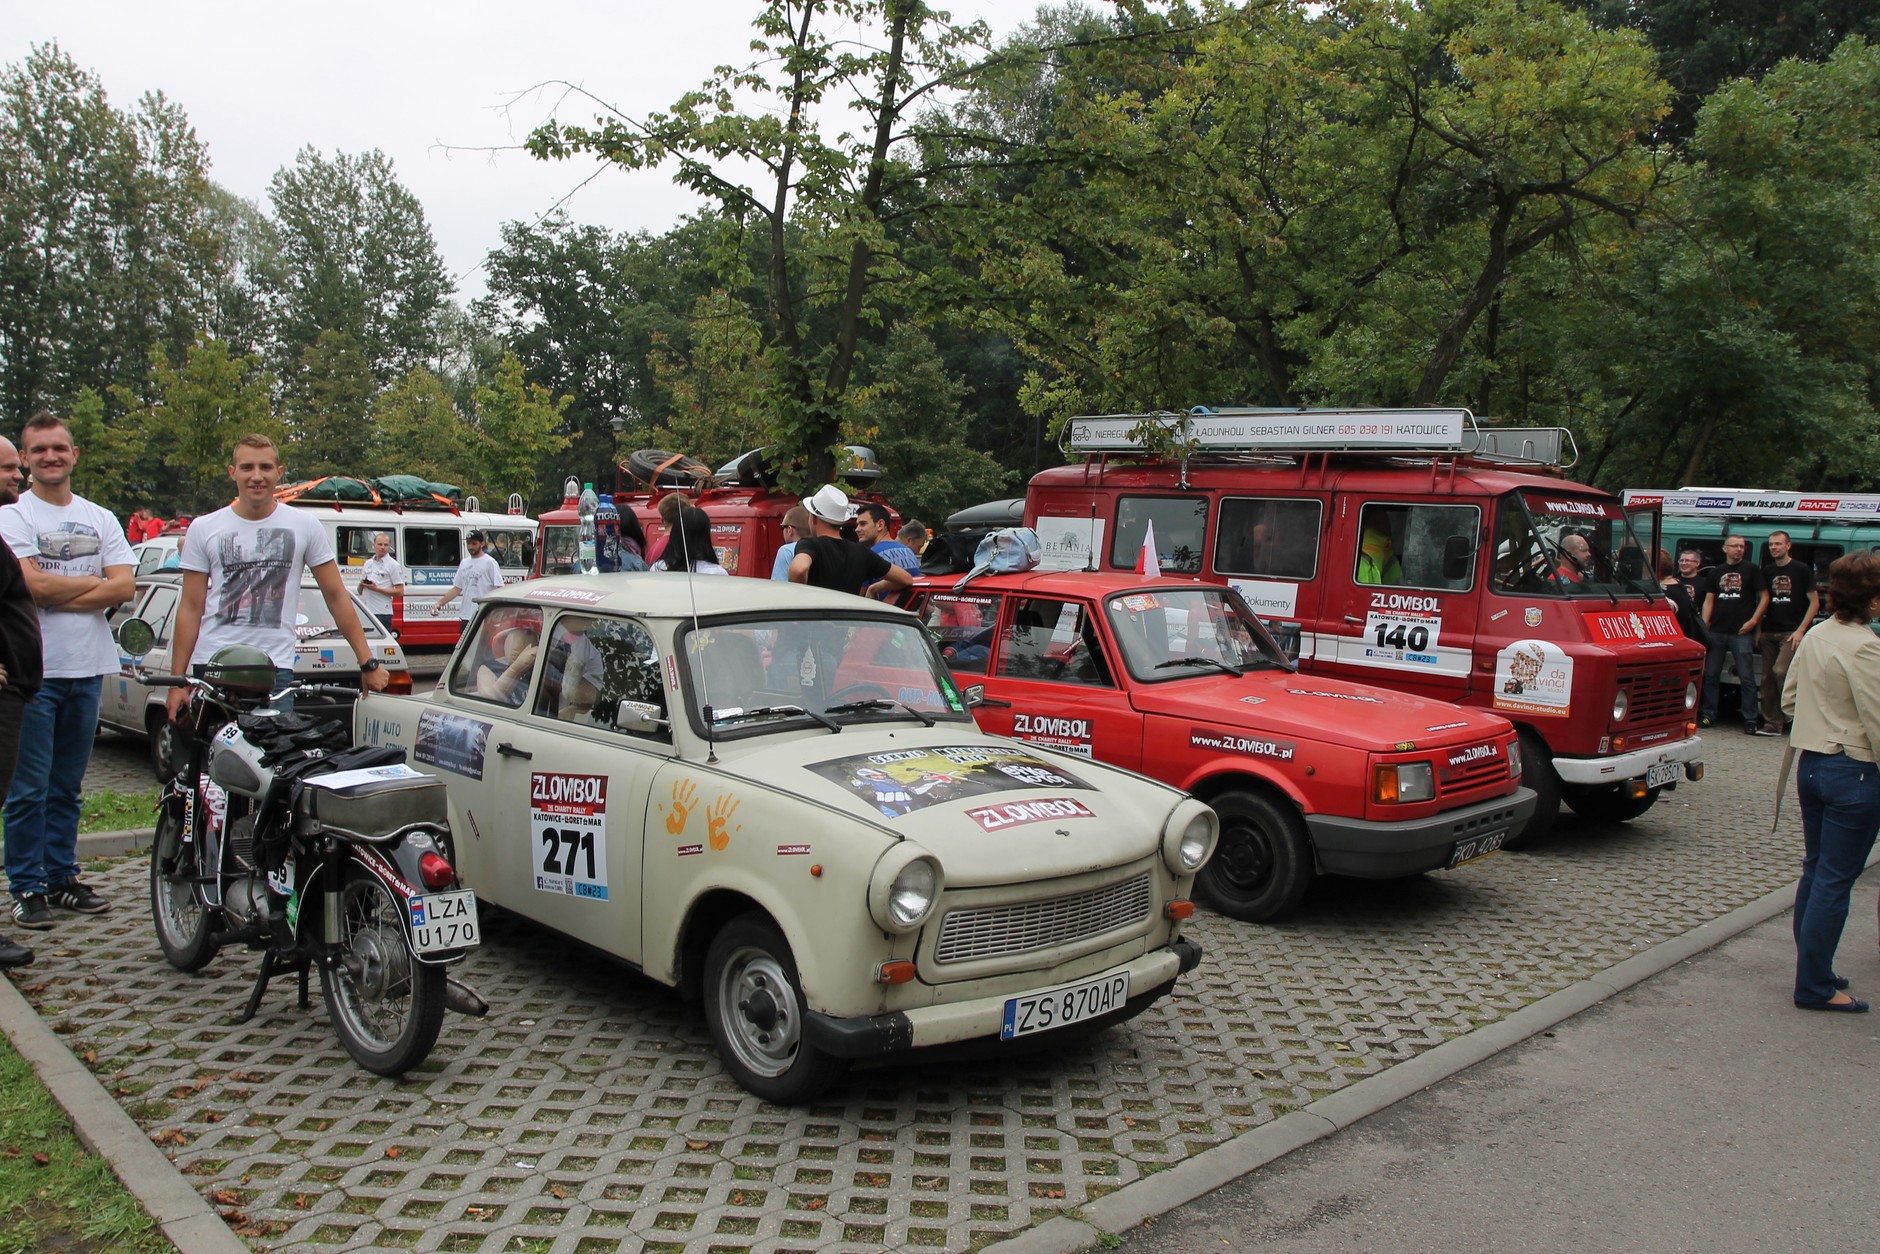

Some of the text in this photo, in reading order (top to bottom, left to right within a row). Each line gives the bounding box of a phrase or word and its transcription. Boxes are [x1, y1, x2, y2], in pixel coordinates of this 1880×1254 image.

[1196, 427, 1244, 437] ŁADUNKÓW
[1250, 425, 1300, 436] SEBASTIAN
[1302, 425, 1335, 435] GILNER
[1338, 425, 1356, 435] 605
[1359, 425, 1378, 435] 030
[1381, 425, 1393, 435] 191
[1396, 424, 1448, 435] KATOWICE
[1697, 499, 1731, 507] SERVICE
[1736, 500, 1795, 509] www.fas.pcp.pl
[1799, 501, 1837, 509] FRANCE
[1598, 617, 1632, 640] GYNSI
[1374, 622, 1429, 652] 140
[1550, 668, 1566, 680] da
[1538, 677, 1565, 687] vinci
[1496, 701, 1566, 715] www.davinci-studio.eu
[222, 726, 238, 739] 99
[383, 721, 401, 737] AUTO
[554, 805, 572, 814] CHARITY
[588, 819, 602, 827] MAR
[542, 827, 596, 879] 271
[400, 884, 416, 897] MAR
[428, 898, 467, 920] LZA
[413, 914, 425, 924] PL
[1018, 978, 1125, 1032] ZS 870AP
[1004, 1024, 1013, 1033] PL
